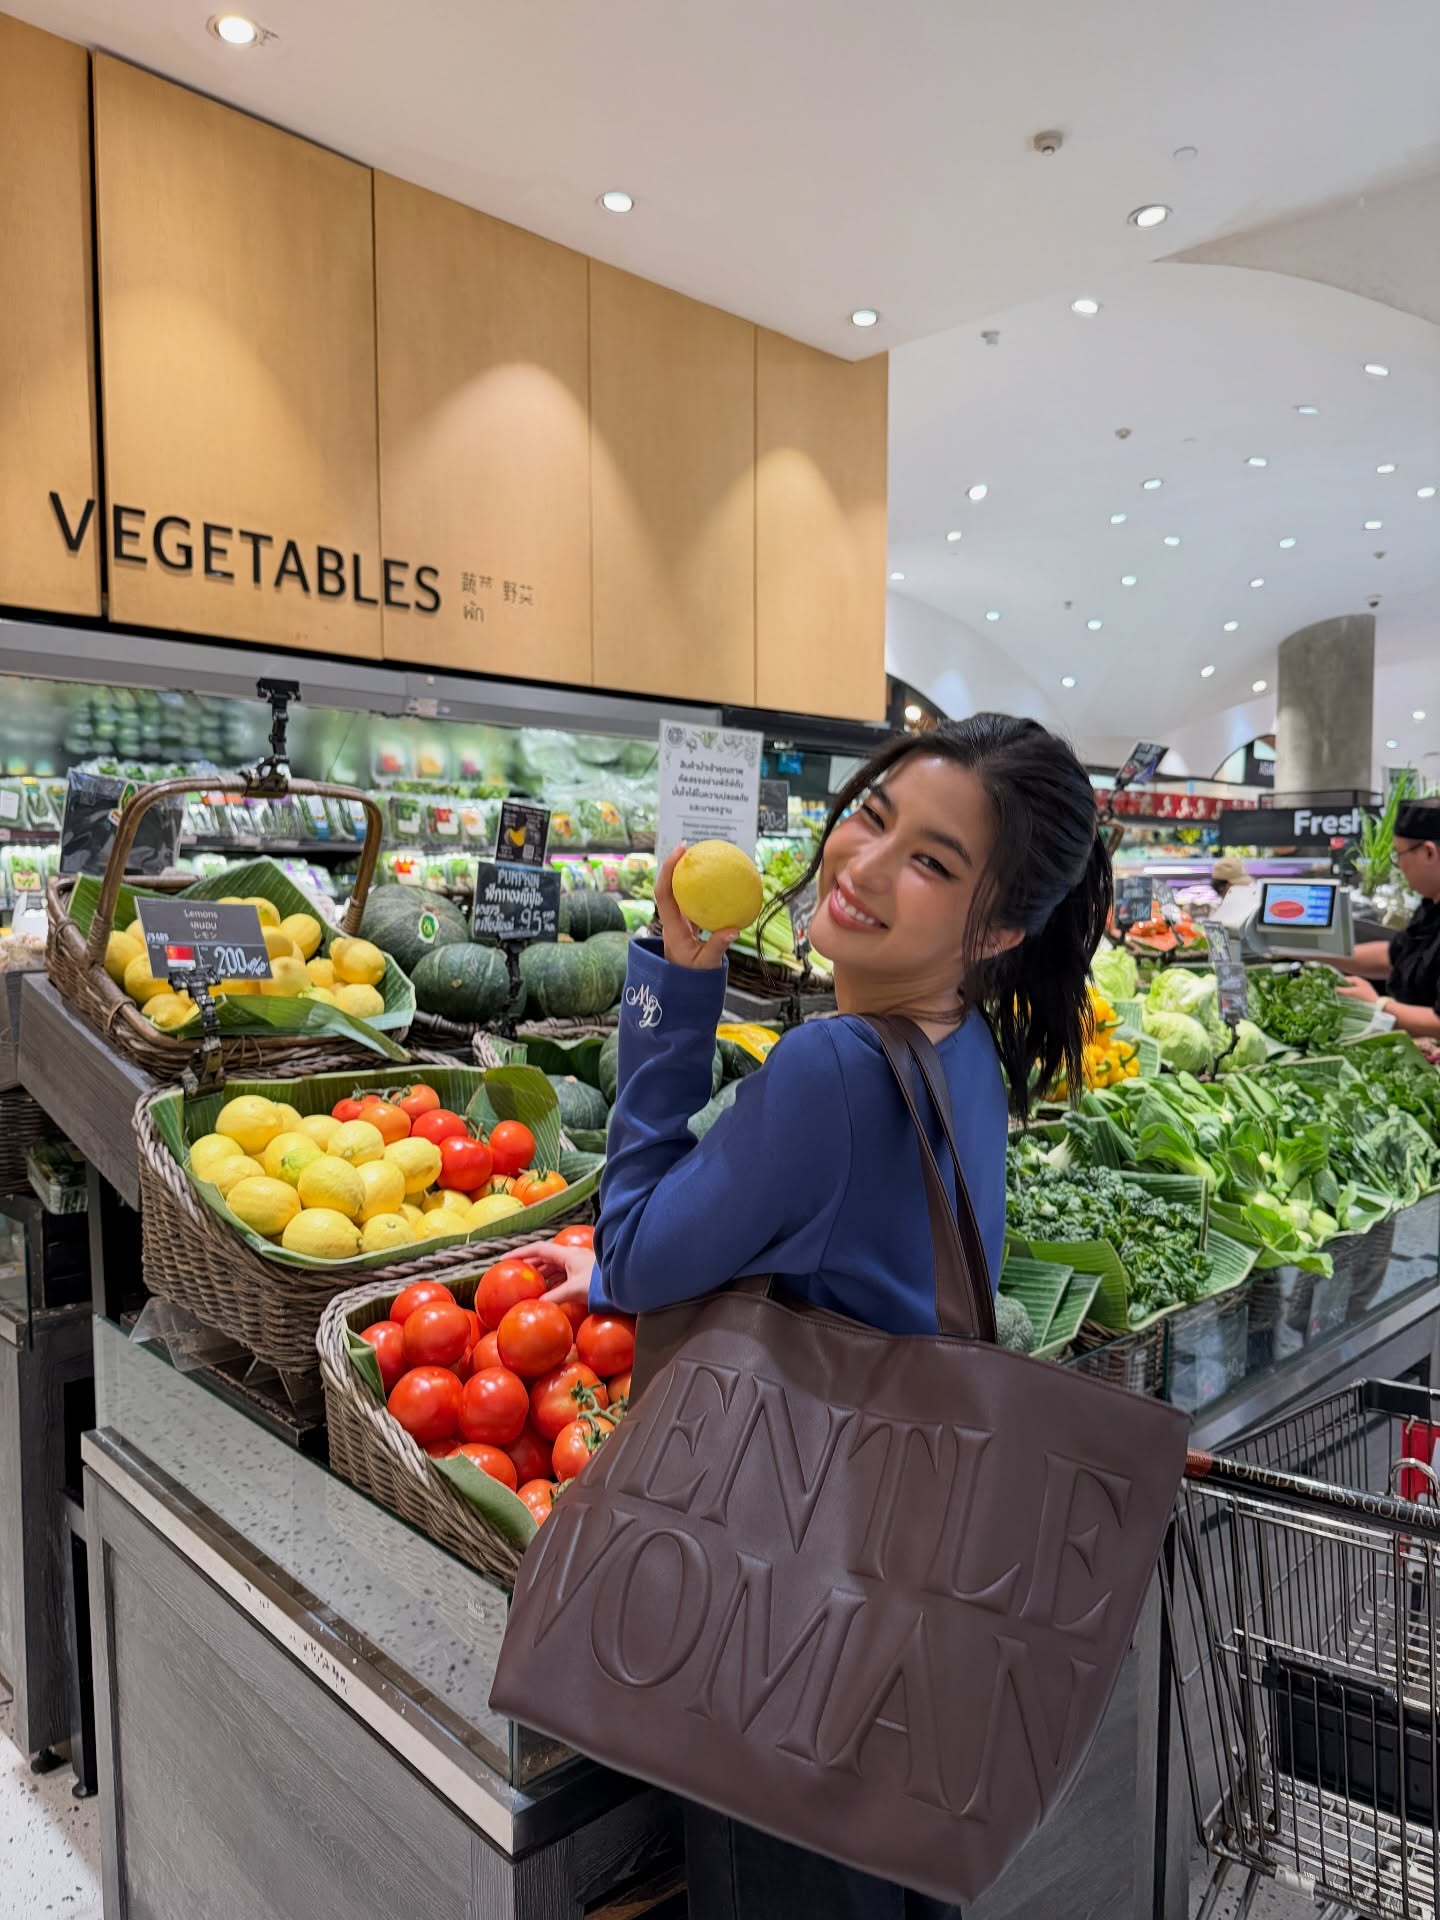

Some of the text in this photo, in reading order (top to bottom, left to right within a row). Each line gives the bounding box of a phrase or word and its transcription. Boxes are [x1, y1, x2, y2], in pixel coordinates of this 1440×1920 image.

[49, 491, 442, 614] VEGETABLES
[184, 909, 218, 919] Lemons
[521, 908, 542, 935] 95
[213, 946, 247, 975] 200
